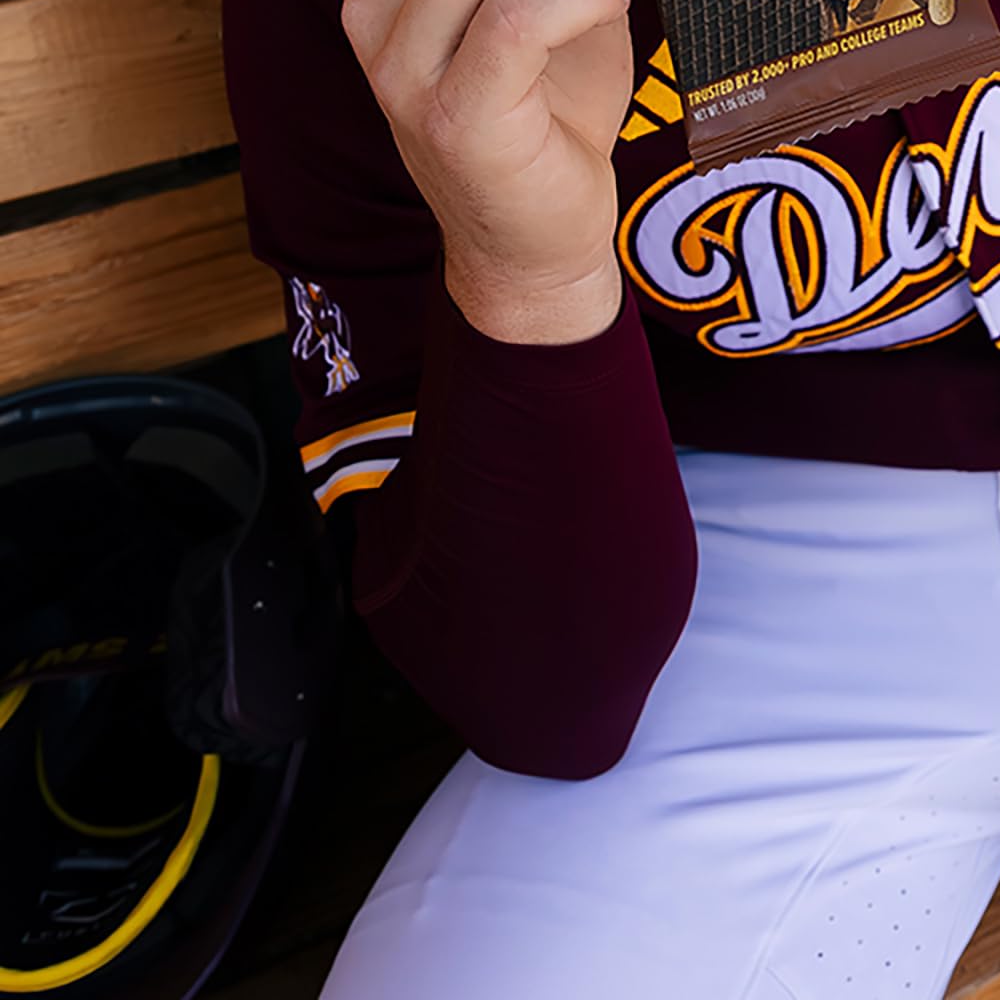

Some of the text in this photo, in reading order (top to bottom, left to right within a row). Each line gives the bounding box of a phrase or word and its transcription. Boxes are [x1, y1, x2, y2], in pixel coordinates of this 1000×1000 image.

[688, 79, 735, 107] TRUSTED
[735, 72, 751, 91] BY
[791, 50, 816, 72] PRO
[816, 42, 840, 62] AND
[840, 27, 887, 54] COLLEGE
[888, 12, 926, 37] TEAMS
